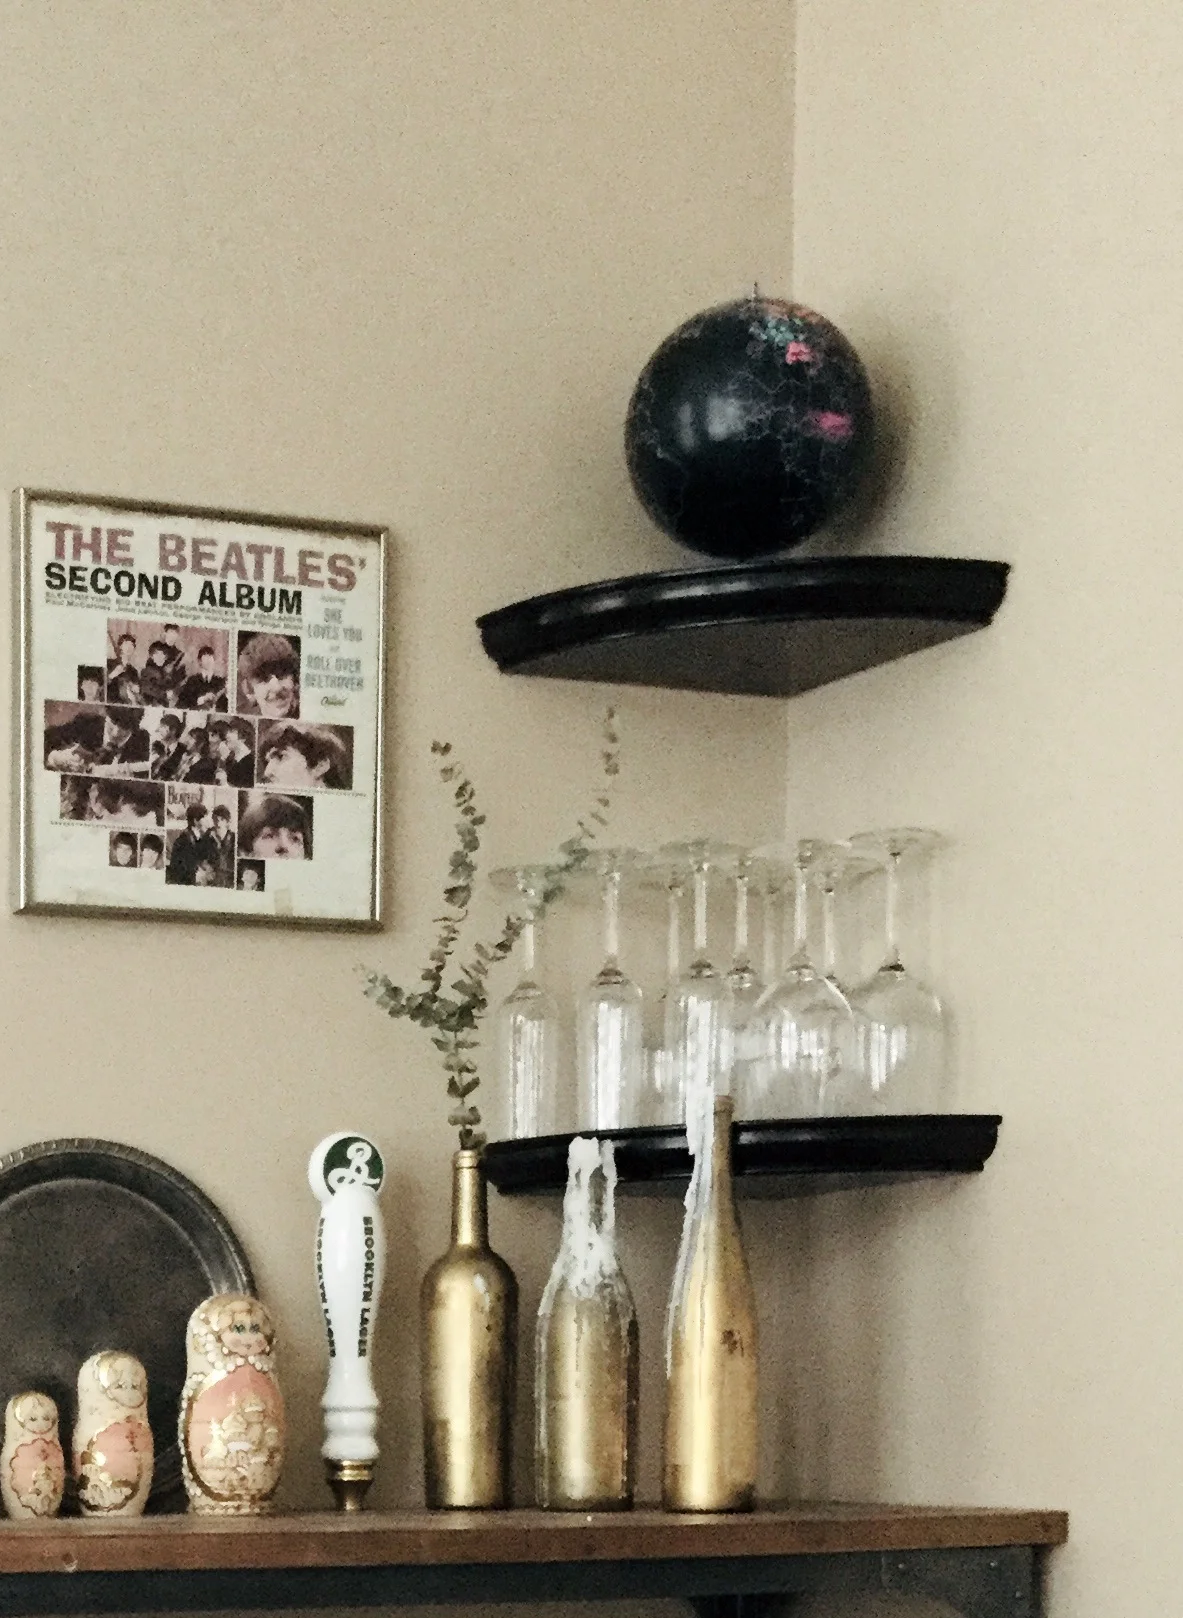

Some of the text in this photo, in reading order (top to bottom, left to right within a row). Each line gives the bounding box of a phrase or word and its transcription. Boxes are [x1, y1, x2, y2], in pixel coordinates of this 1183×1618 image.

[45, 521, 367, 593] THE BEATLES'
[45, 562, 303, 616] SECOND ALBUM
